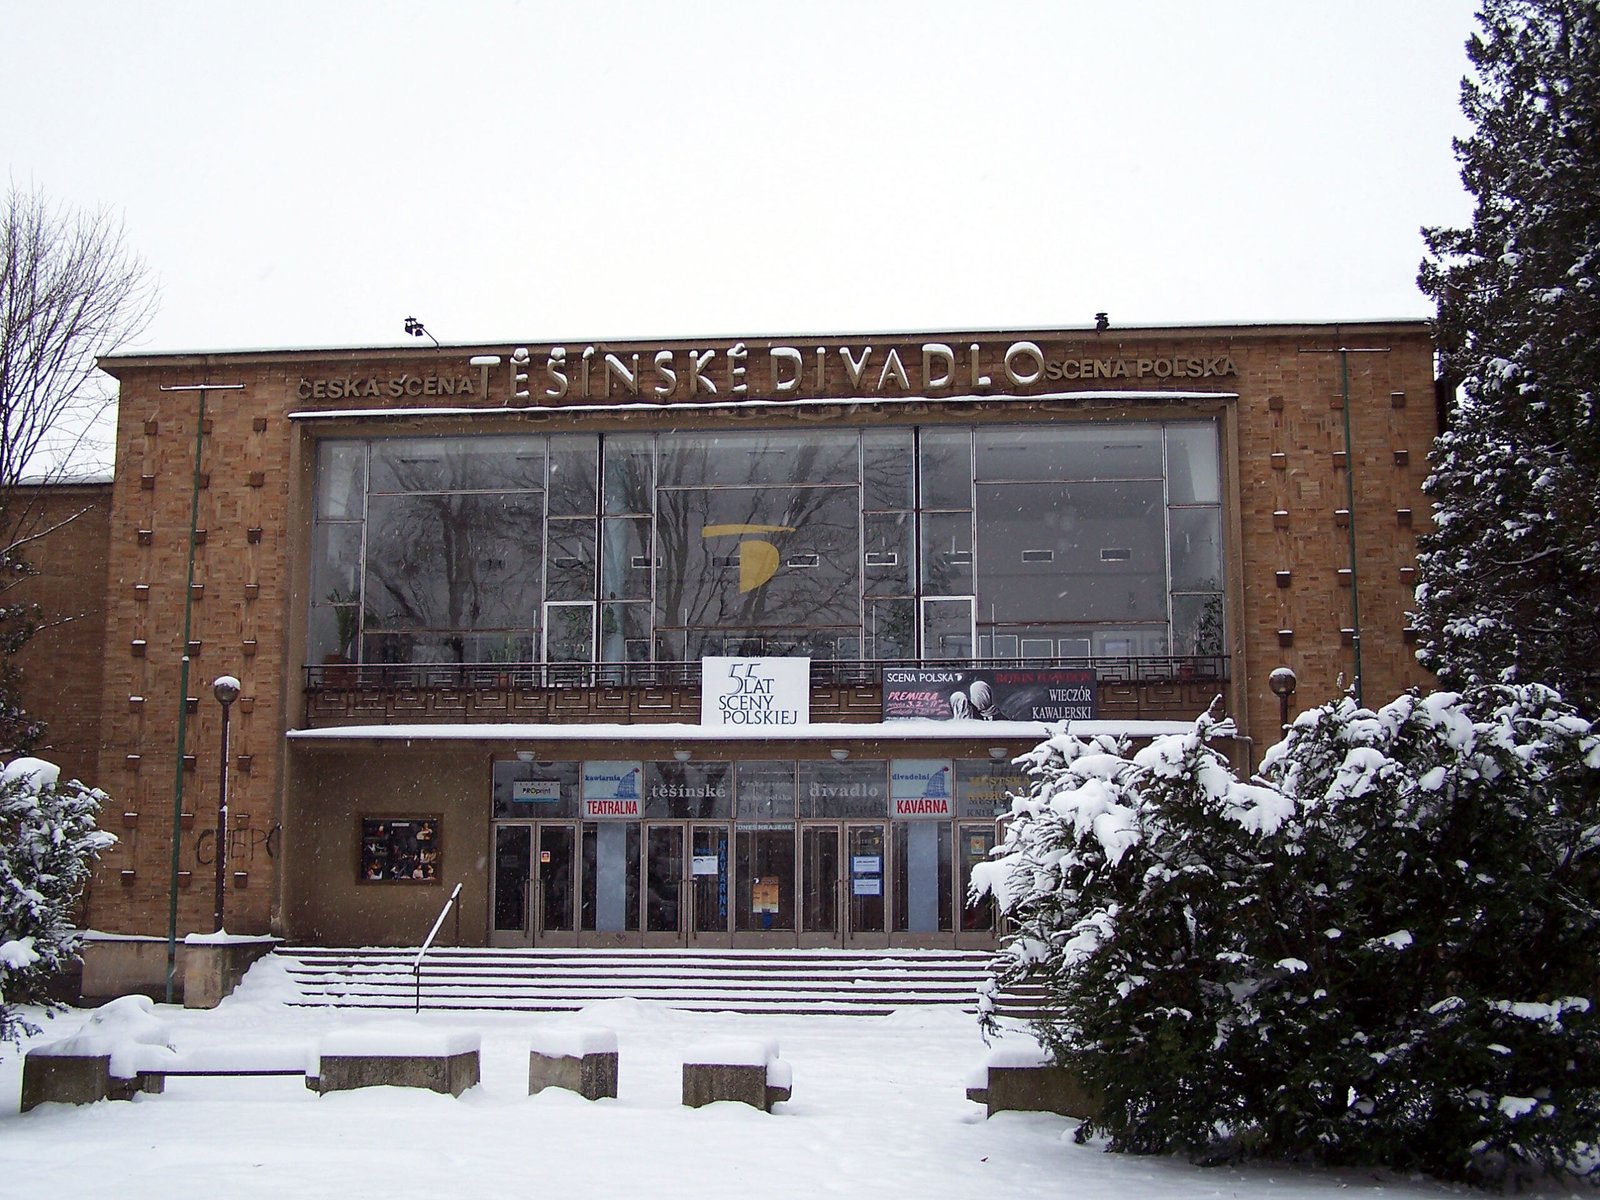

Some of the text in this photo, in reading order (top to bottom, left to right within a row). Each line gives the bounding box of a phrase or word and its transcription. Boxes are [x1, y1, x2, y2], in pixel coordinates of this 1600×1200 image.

[470, 341, 1046, 399] TĚŠÍNSKÉ DIVADLO
[1045, 355, 1240, 380] SCENA POLSKA
[725, 663, 775, 695] 55 LAT
[887, 672, 954, 682] SCENA POLSKA
[887, 691, 939, 701] PREMIERA
[1049, 685, 1092, 701] WIECZÓR
[719, 695, 774, 710] SCENY
[723, 710, 798, 725] POLSKIEJ
[1032, 706, 1091, 719] KAWALERSKI
[652, 782, 726, 798] těšínské
[808, 781, 878, 797] divadlo
[587, 800, 638, 814] TEATRALNA
[896, 796, 948, 814] KAVÁRNA
